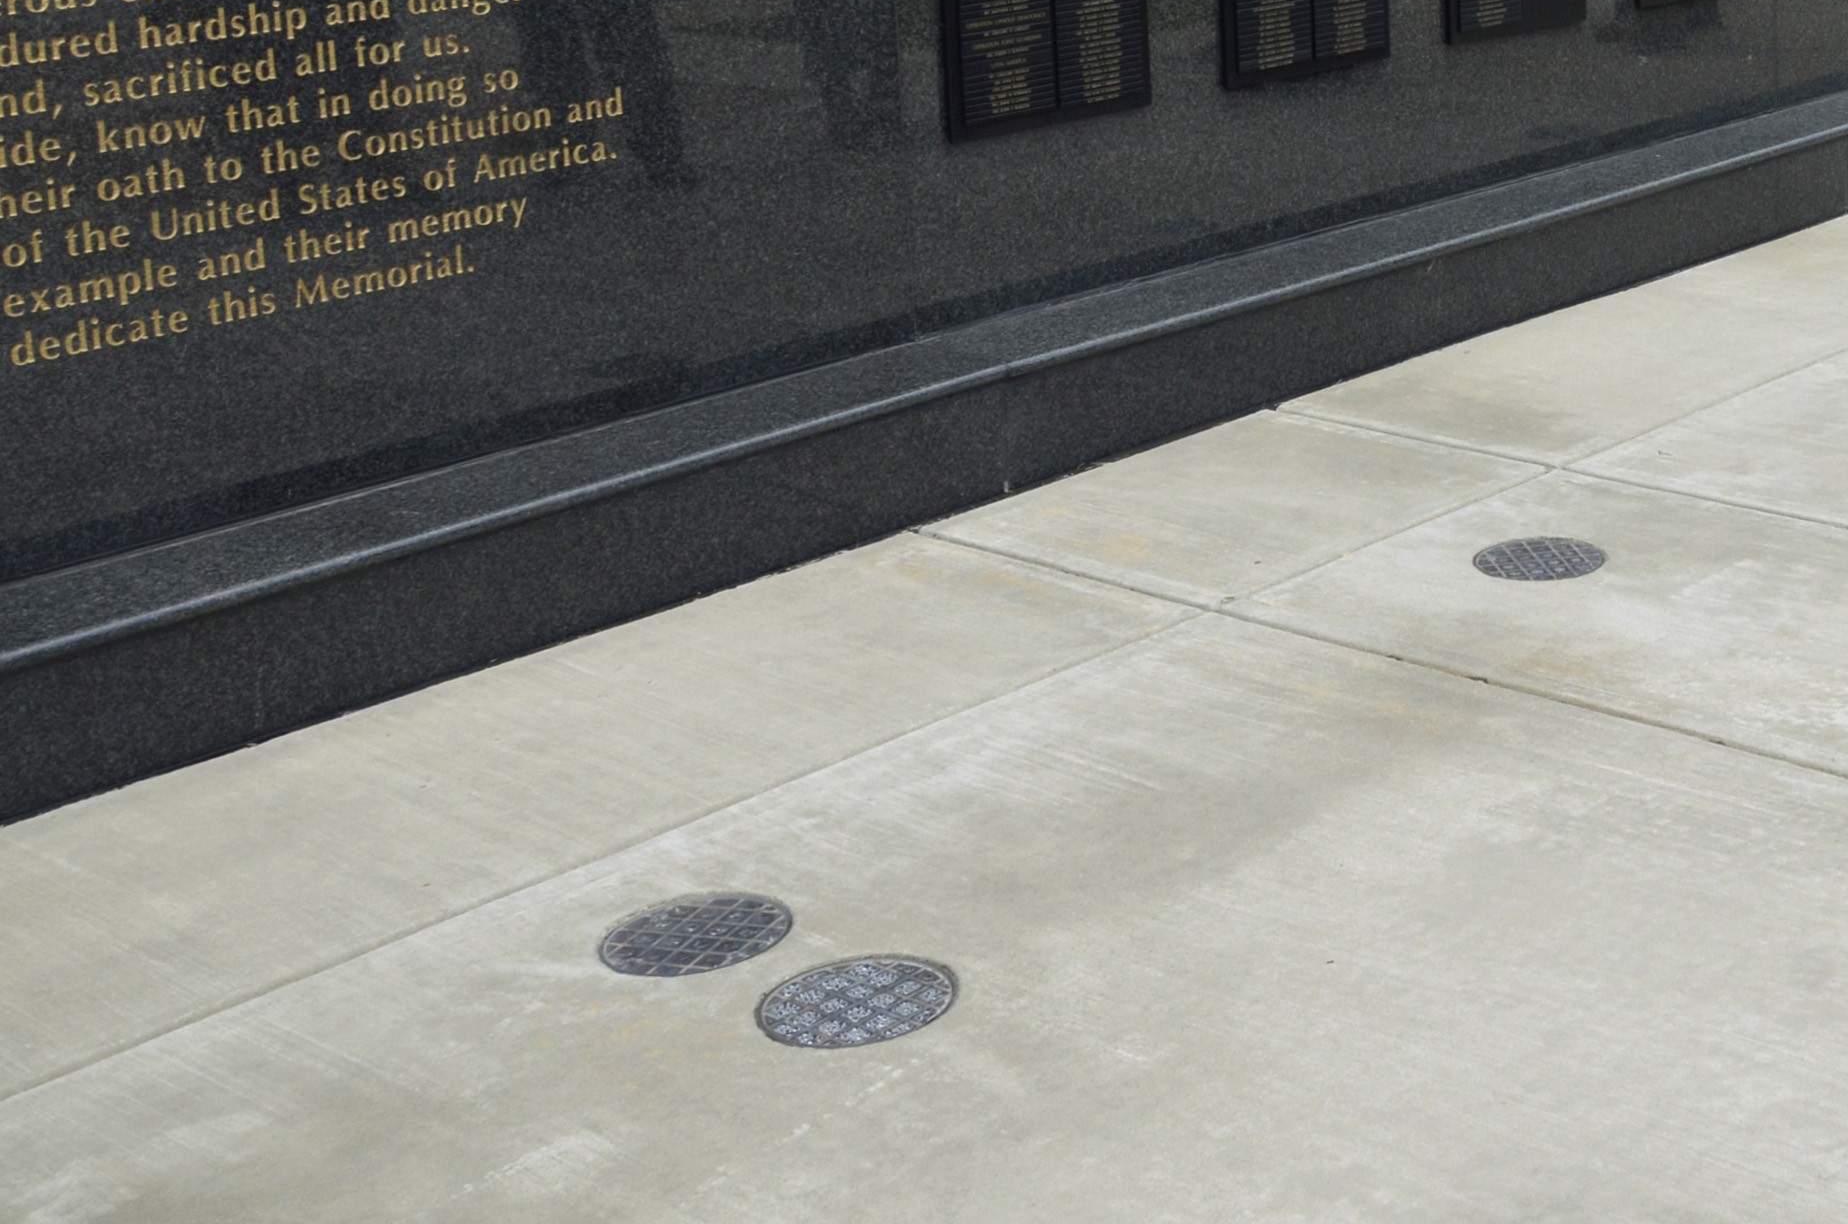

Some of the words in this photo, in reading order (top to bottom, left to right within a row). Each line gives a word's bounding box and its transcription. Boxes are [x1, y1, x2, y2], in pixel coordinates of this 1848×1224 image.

[0, 19, 120, 68] dured
[137, 0, 308, 51] hardship
[0, 78, 63, 120] nd,
[82, 47, 277, 107] sacrificed
[295, 39, 338, 77] all
[354, 35, 406, 68] for
[422, 35, 471, 59] us.
[0, 129, 78, 170] ide,
[95, 115, 207, 154] know
[225, 95, 301, 134] that
[318, 87, 352, 120] in
[368, 73, 469, 112] doing
[482, 68, 520, 94] so
[96, 157, 187, 202] oath
[204, 155, 245, 185] to
[261, 138, 321, 175] the
[337, 104, 553, 162] Constitution
[566, 86, 624, 124] and
[1, 227, 44, 268] of
[65, 219, 130, 258] the
[150, 187, 281, 242] United
[298, 175, 408, 215] States
[423, 156, 457, 192] of
[474, 137, 618, 183] America.
[2, 257, 177, 318] example
[197, 236, 267, 282] and
[283, 220, 370, 265] their
[388, 198, 527, 245] memory
[10, 308, 190, 367] dedicate
[207, 284, 278, 326] this
[294, 243, 476, 308] Memorial.
